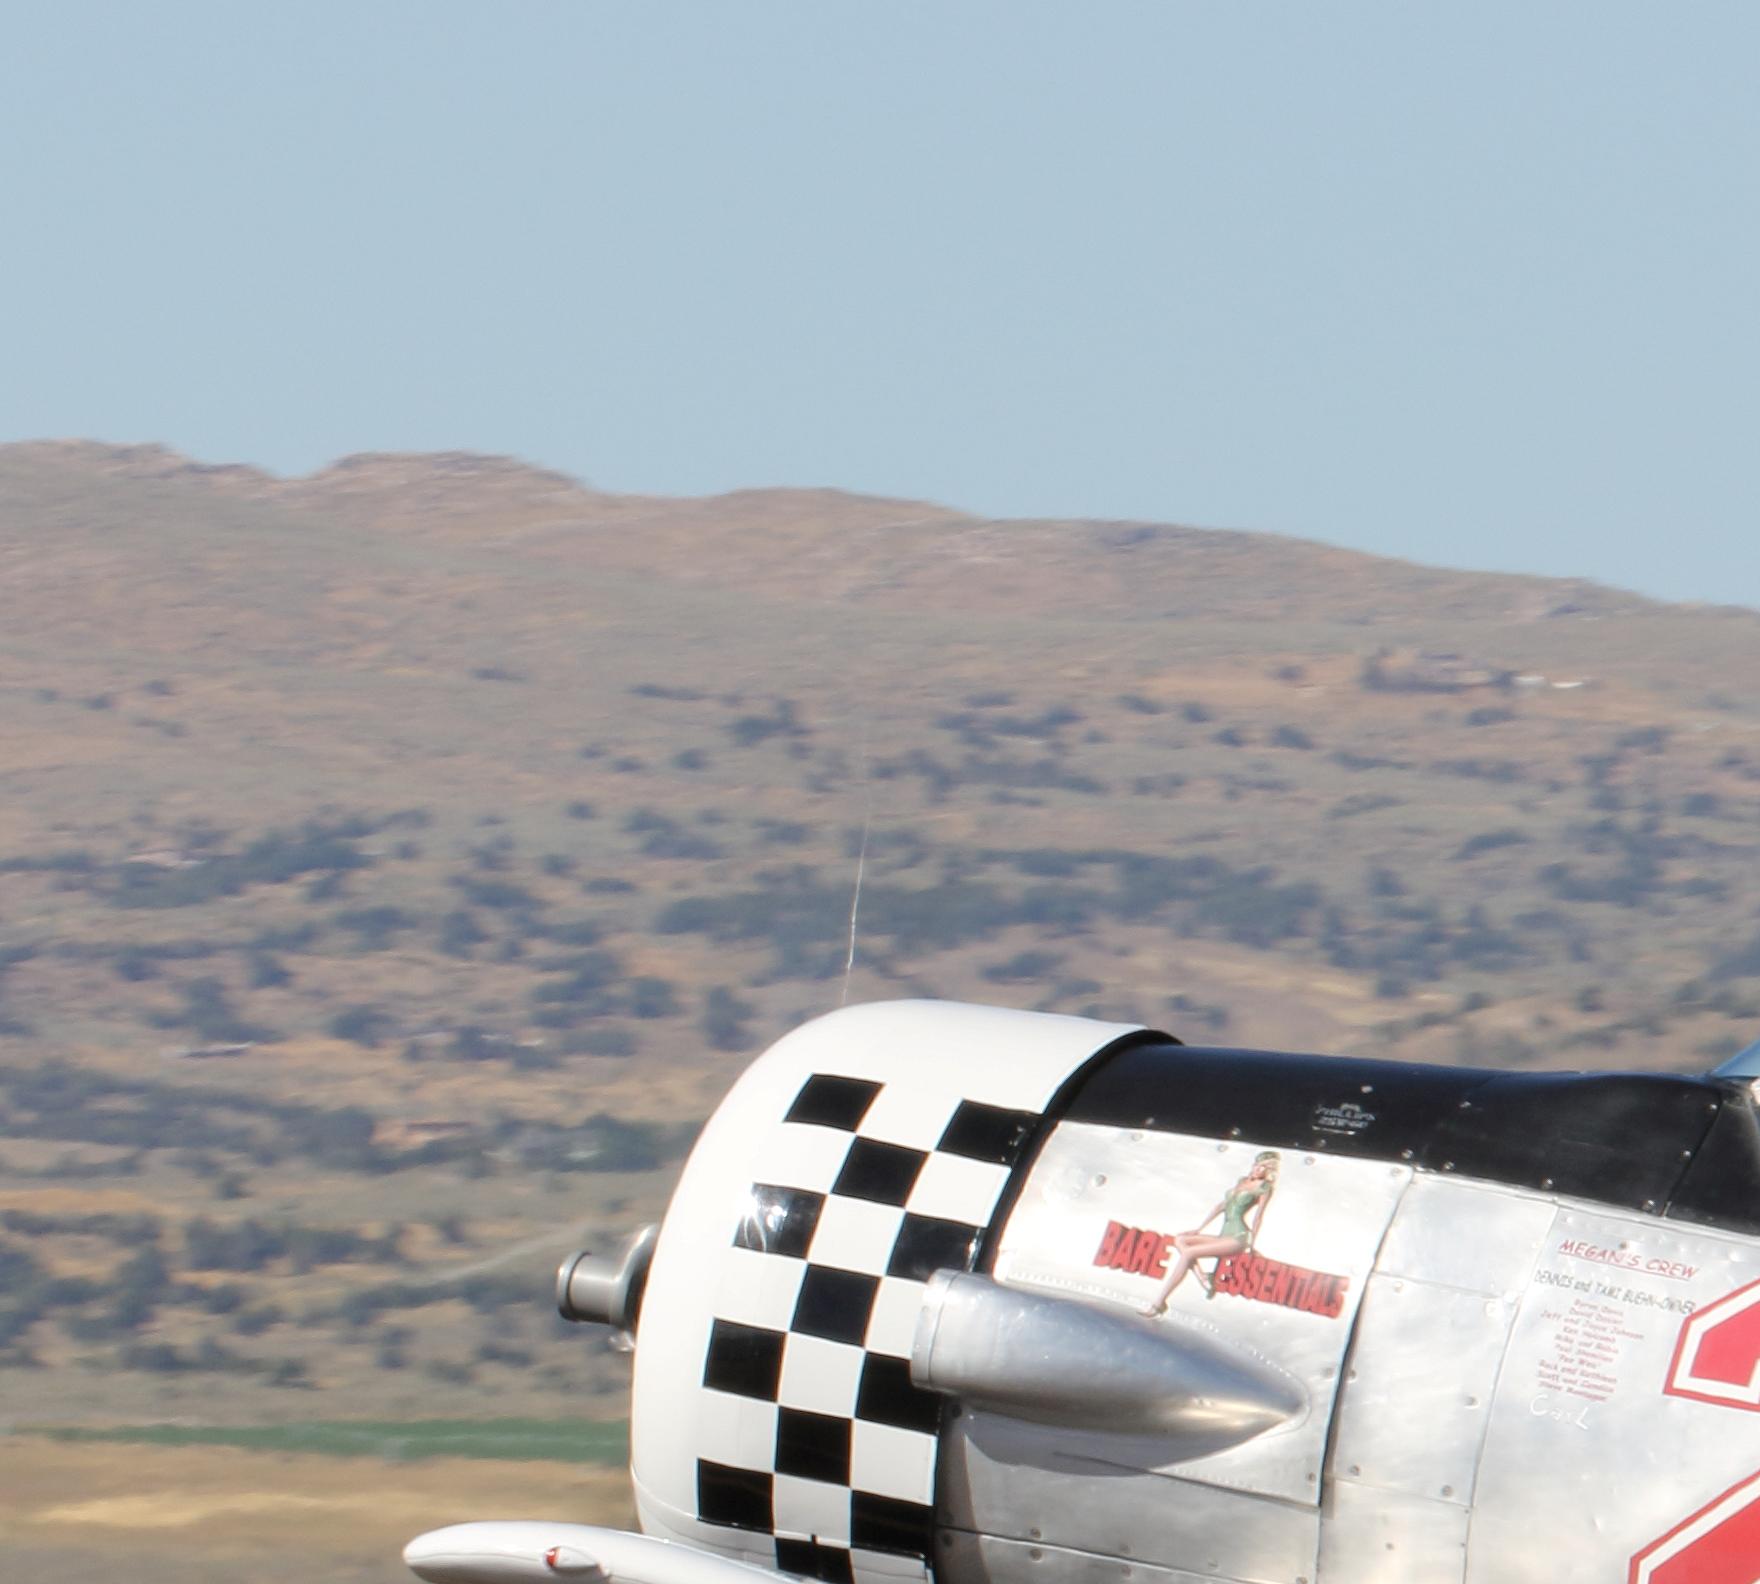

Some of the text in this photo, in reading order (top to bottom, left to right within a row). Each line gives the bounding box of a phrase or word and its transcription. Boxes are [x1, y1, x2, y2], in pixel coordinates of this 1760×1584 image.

[1093, 1220, 1350, 1319] BARE ESSENTIALS
[1560, 1239, 1700, 1279] MEGAN'S CREW
